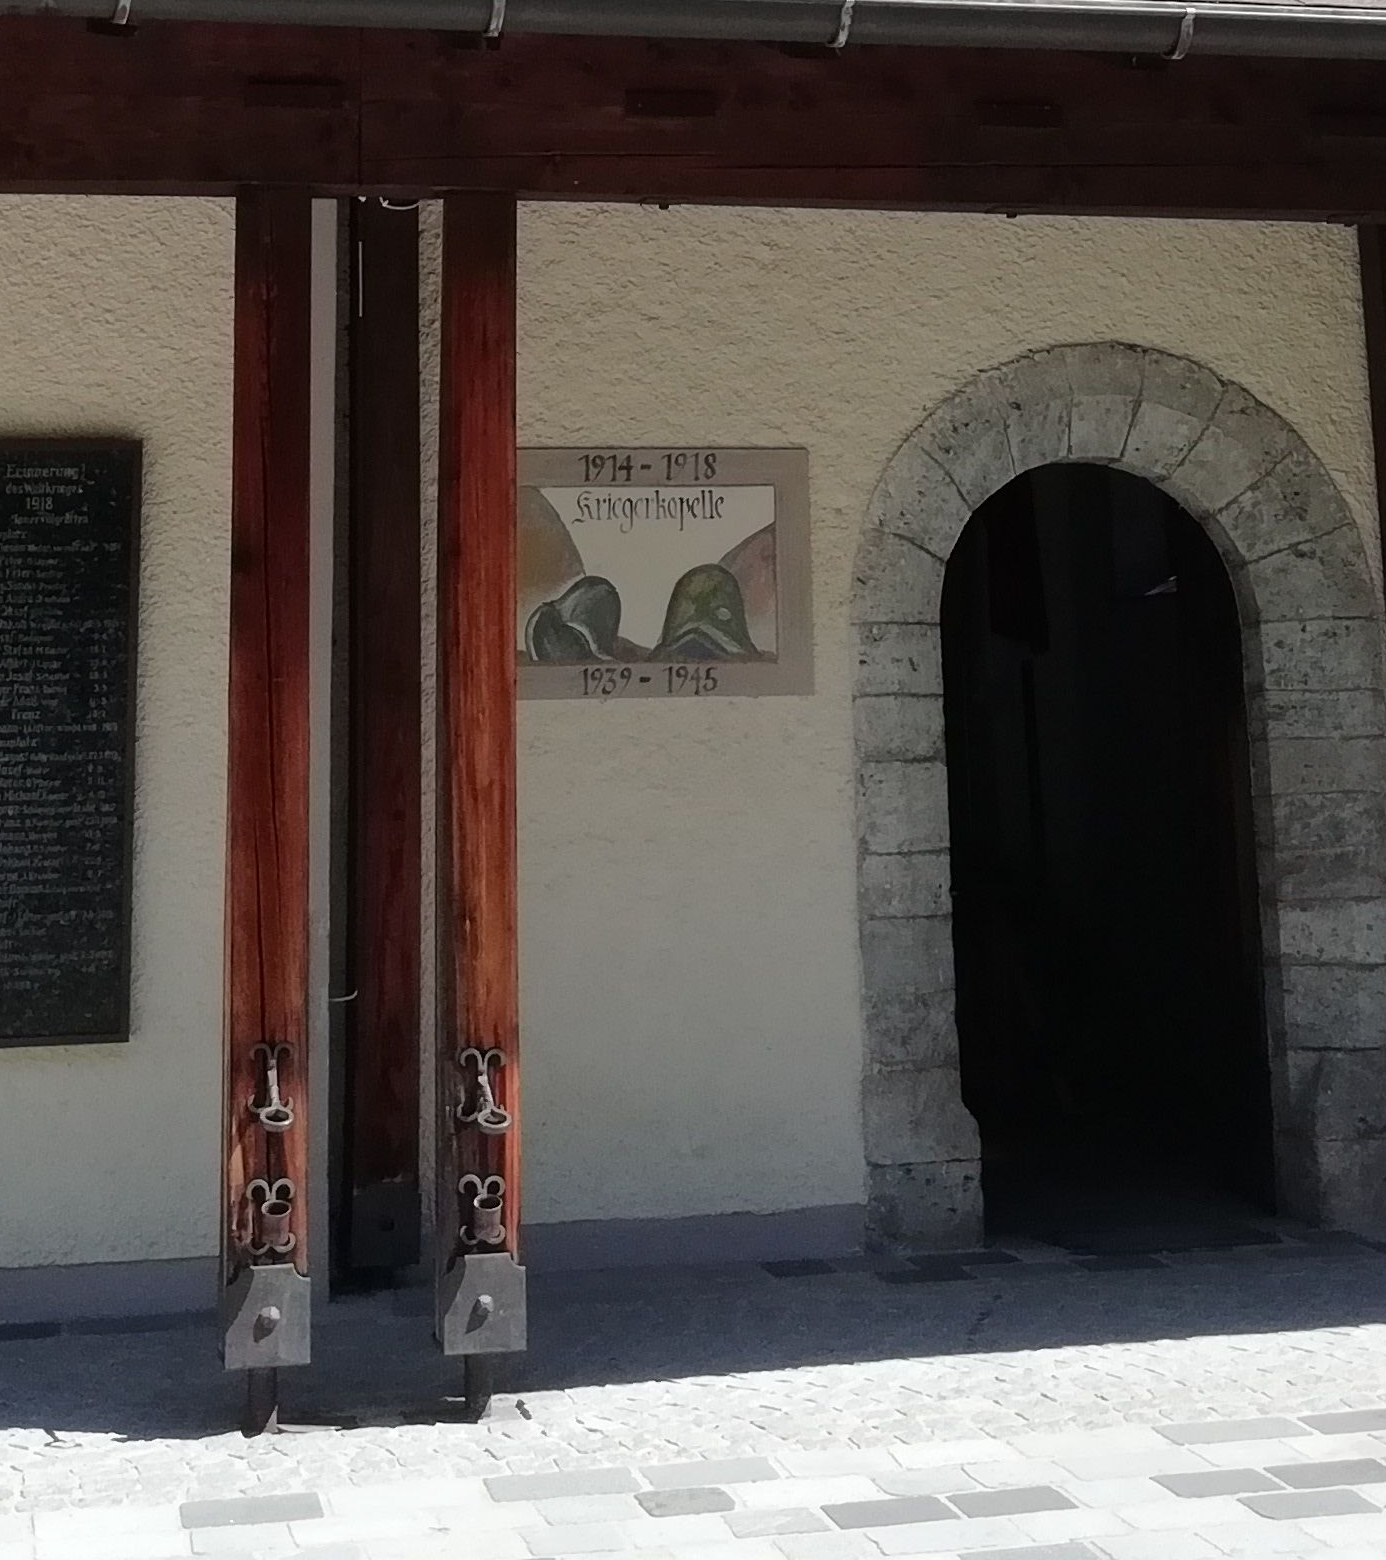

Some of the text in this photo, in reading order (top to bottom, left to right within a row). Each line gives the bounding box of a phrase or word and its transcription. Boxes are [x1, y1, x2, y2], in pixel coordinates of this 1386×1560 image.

[577, 453, 633, 481] 1914
[661, 452, 717, 481] 1918
[26, 496, 53, 511] 1918
[579, 666, 632, 695] 1939
[663, 665, 718, 695] 1945
